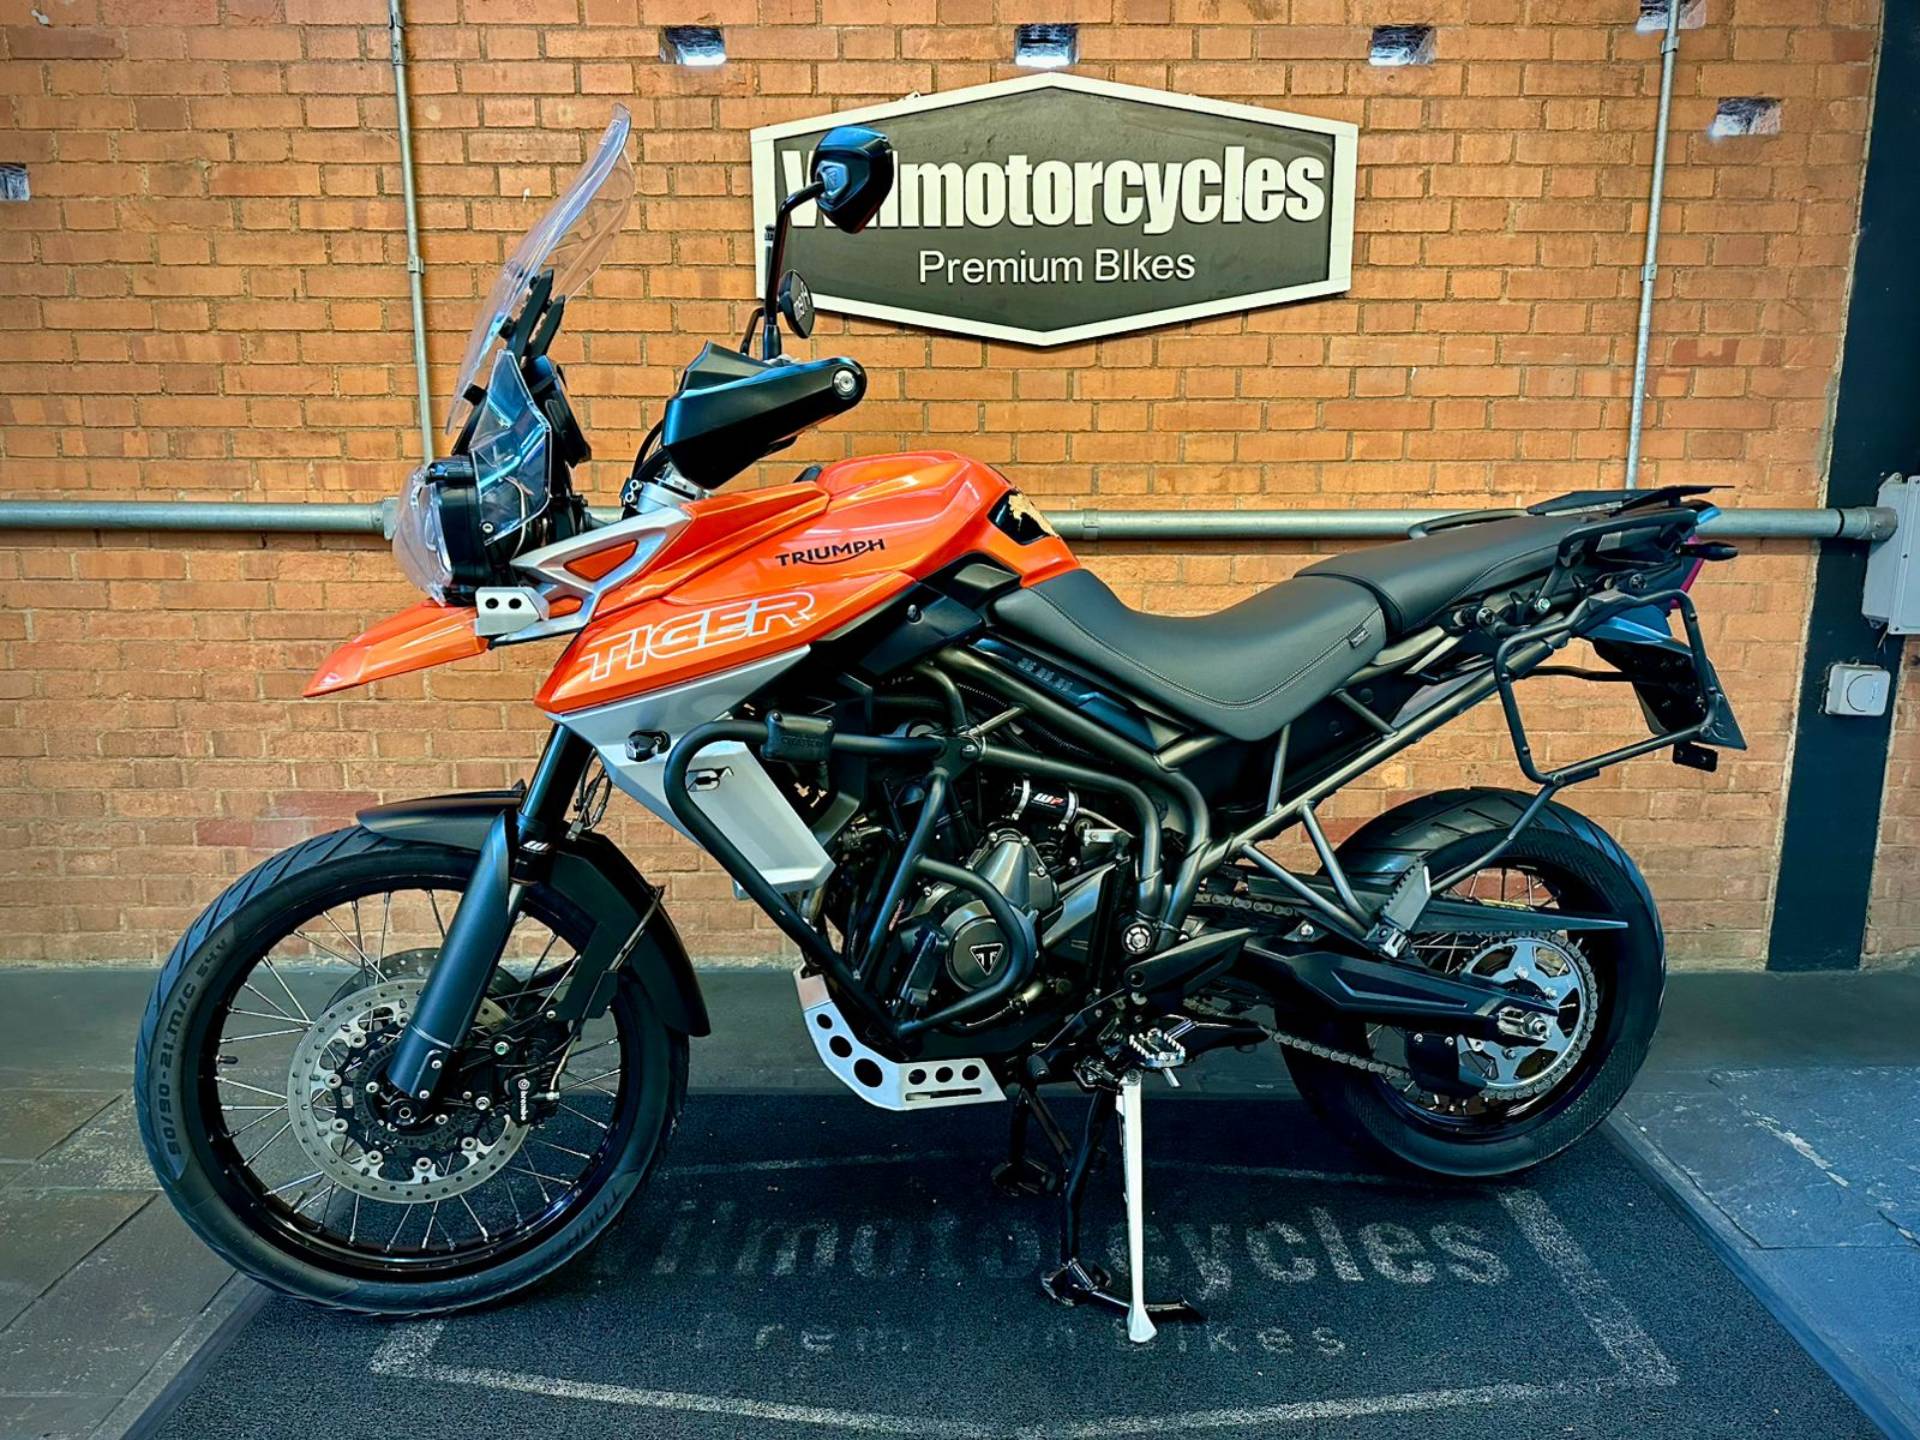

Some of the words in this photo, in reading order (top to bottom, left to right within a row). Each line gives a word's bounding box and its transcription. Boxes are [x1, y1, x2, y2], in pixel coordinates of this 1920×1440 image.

[781, 146, 1325, 235] lmotorcycles
[919, 249, 1083, 283] Premium
[775, 538, 886, 566] TRIUMPH
[577, 591, 816, 682] TIGER
[520, 1090, 529, 1121] brembo
